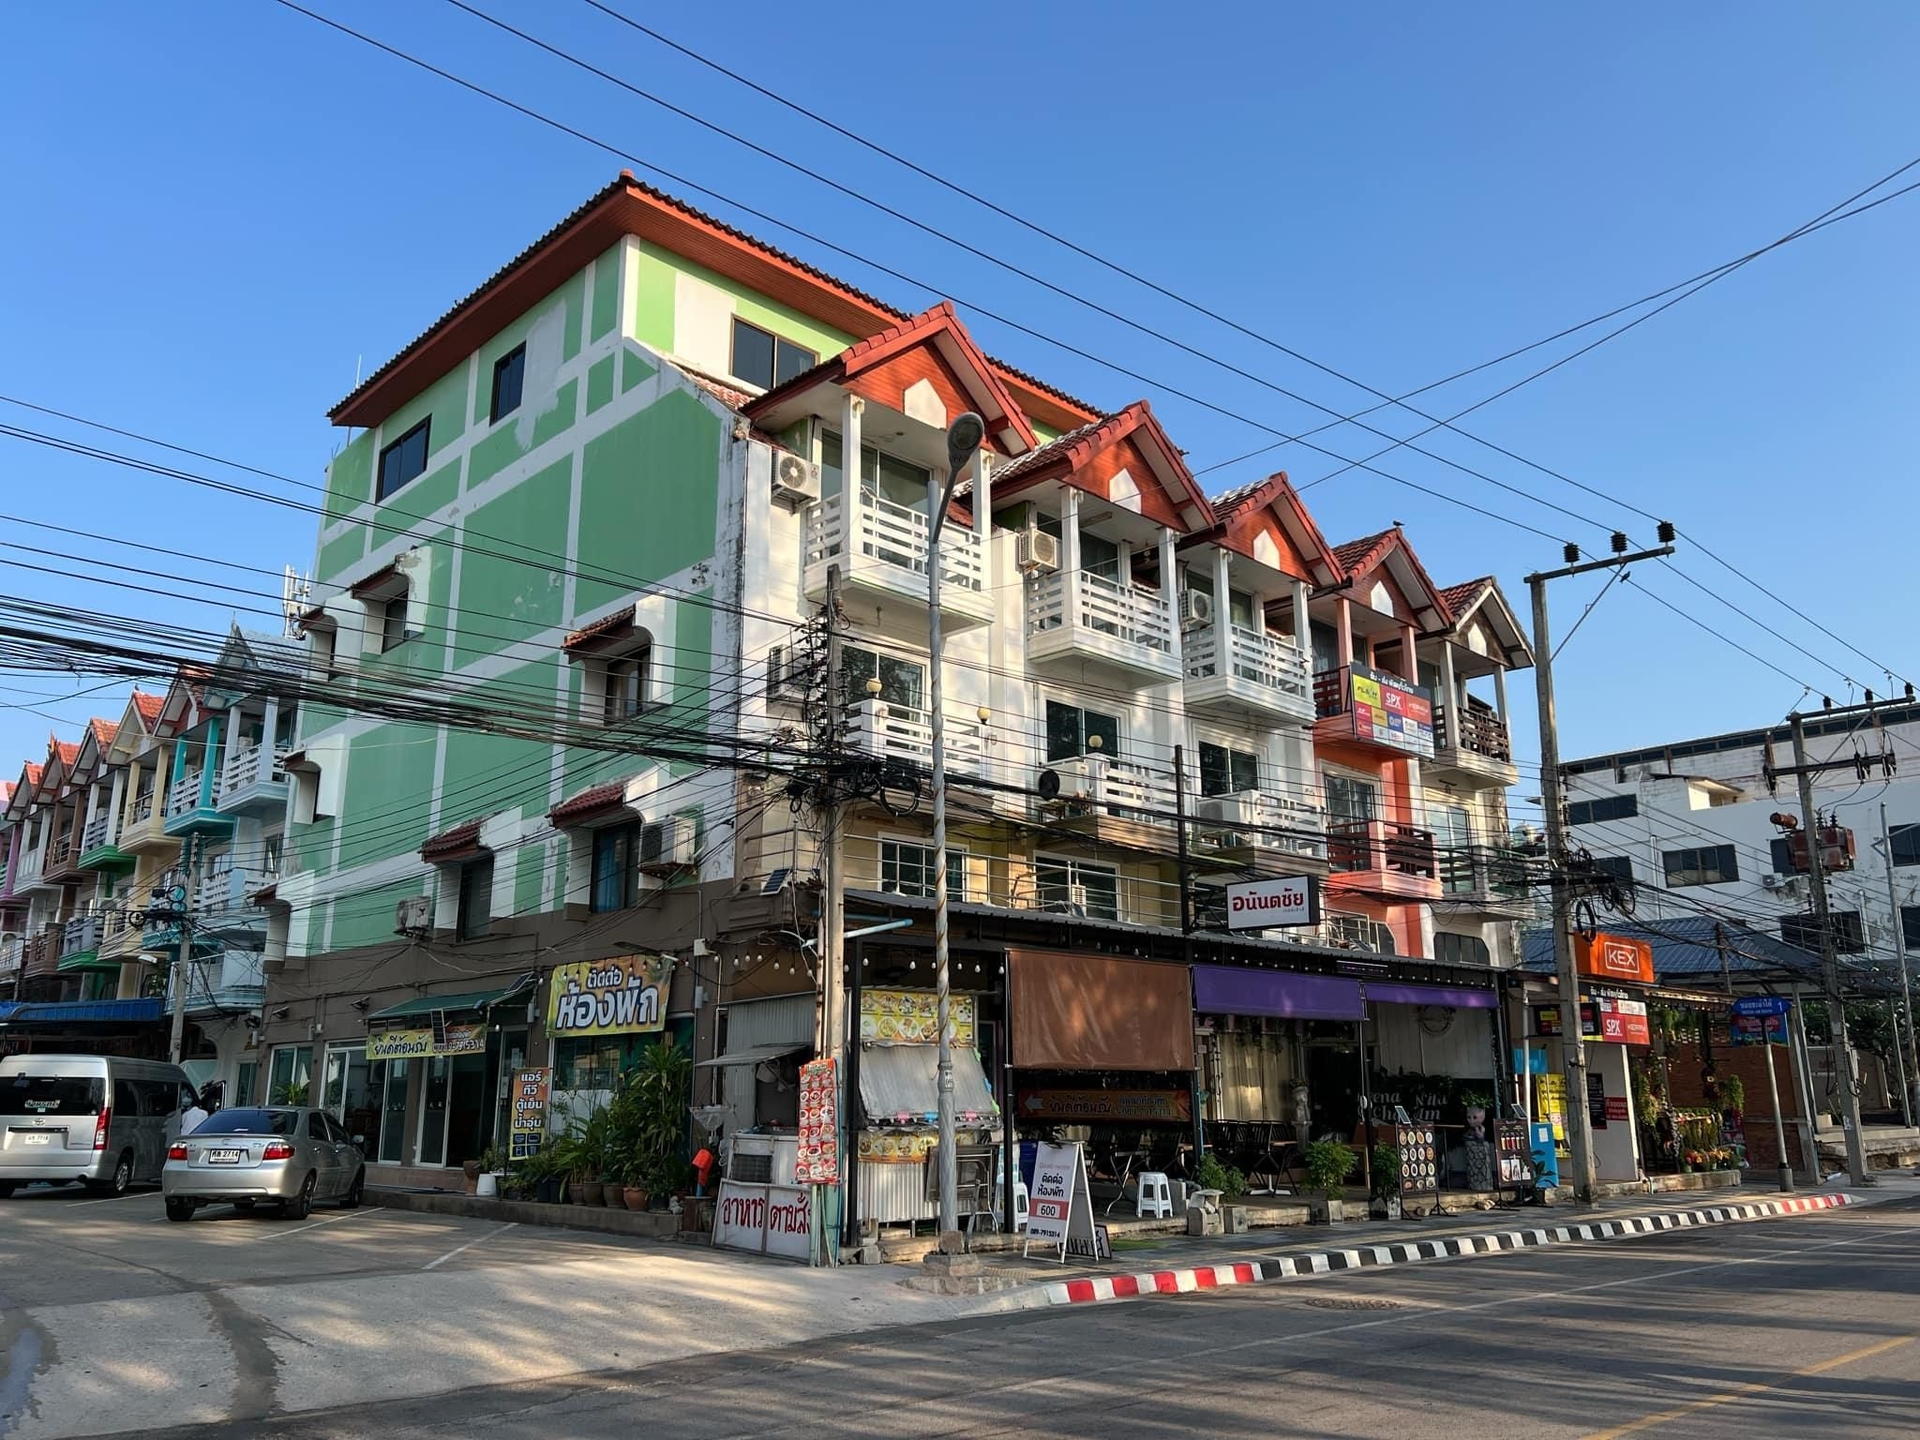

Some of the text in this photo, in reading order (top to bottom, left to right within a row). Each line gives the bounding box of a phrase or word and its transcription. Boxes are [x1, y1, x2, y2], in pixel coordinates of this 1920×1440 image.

[1386, 692, 1401, 708] SPX
[1232, 887, 1304, 911] อนันตชัย
[1608, 949, 1635, 966] KEX
[587, 965, 622, 988] ติดต่อ
[556, 976, 658, 1028] ห้องพัก
[1606, 1019, 1621, 1033] SPX
[521, 1071, 542, 1081] แอร์
[523, 1084, 537, 1095] ทีวี
[516, 1098, 543, 1112] ตู้เย็น
[1042, 1173, 1063, 1184] ติดต่อ
[1037, 1184, 1064, 1197] ห้องพัก
[722, 1192, 810, 1234] อาหาร ตามสั่
[1040, 1205, 1056, 1216] 600
